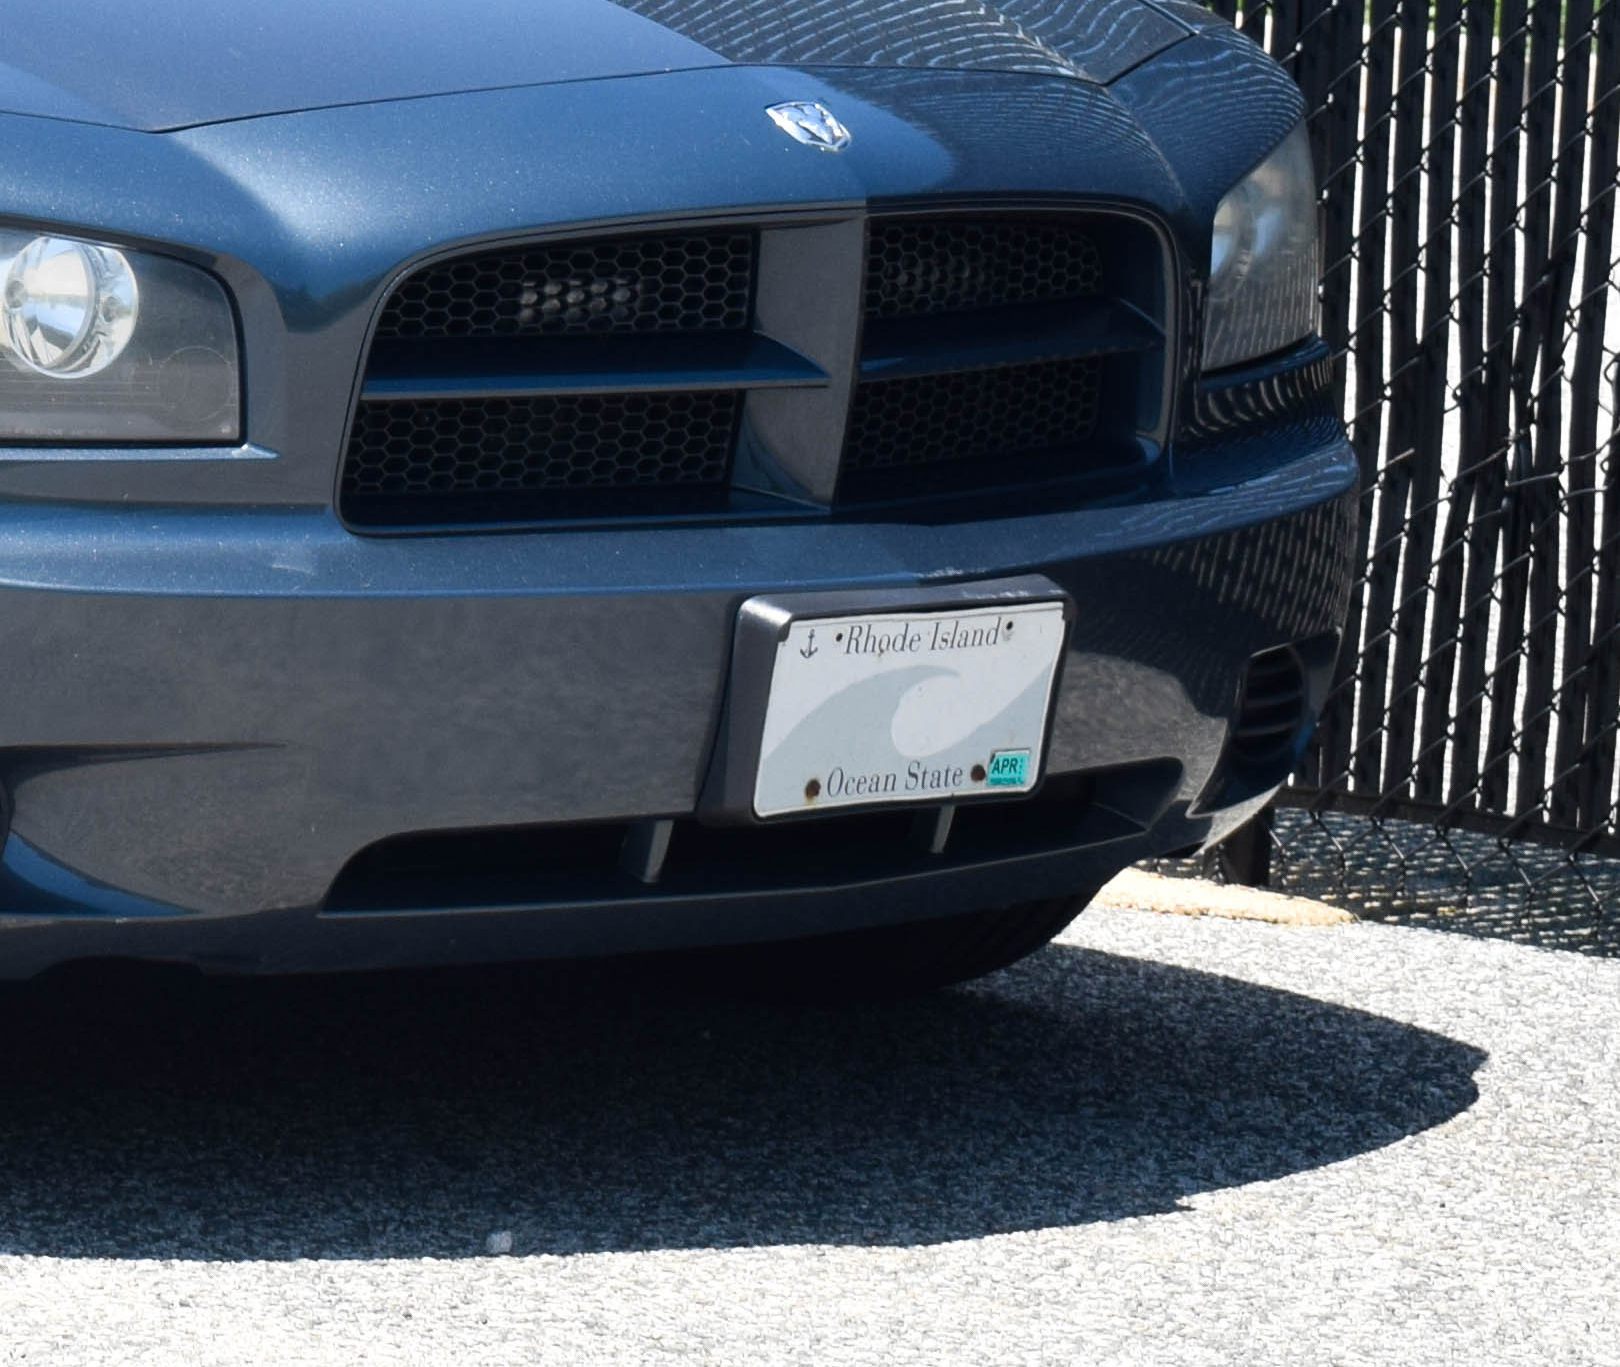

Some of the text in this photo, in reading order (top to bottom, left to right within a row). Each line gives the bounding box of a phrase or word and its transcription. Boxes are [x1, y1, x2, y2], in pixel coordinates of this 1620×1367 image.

[846, 617, 1002, 654] Rhode Island
[827, 760, 963, 797] Ocean State
[991, 757, 1018, 774] APR
